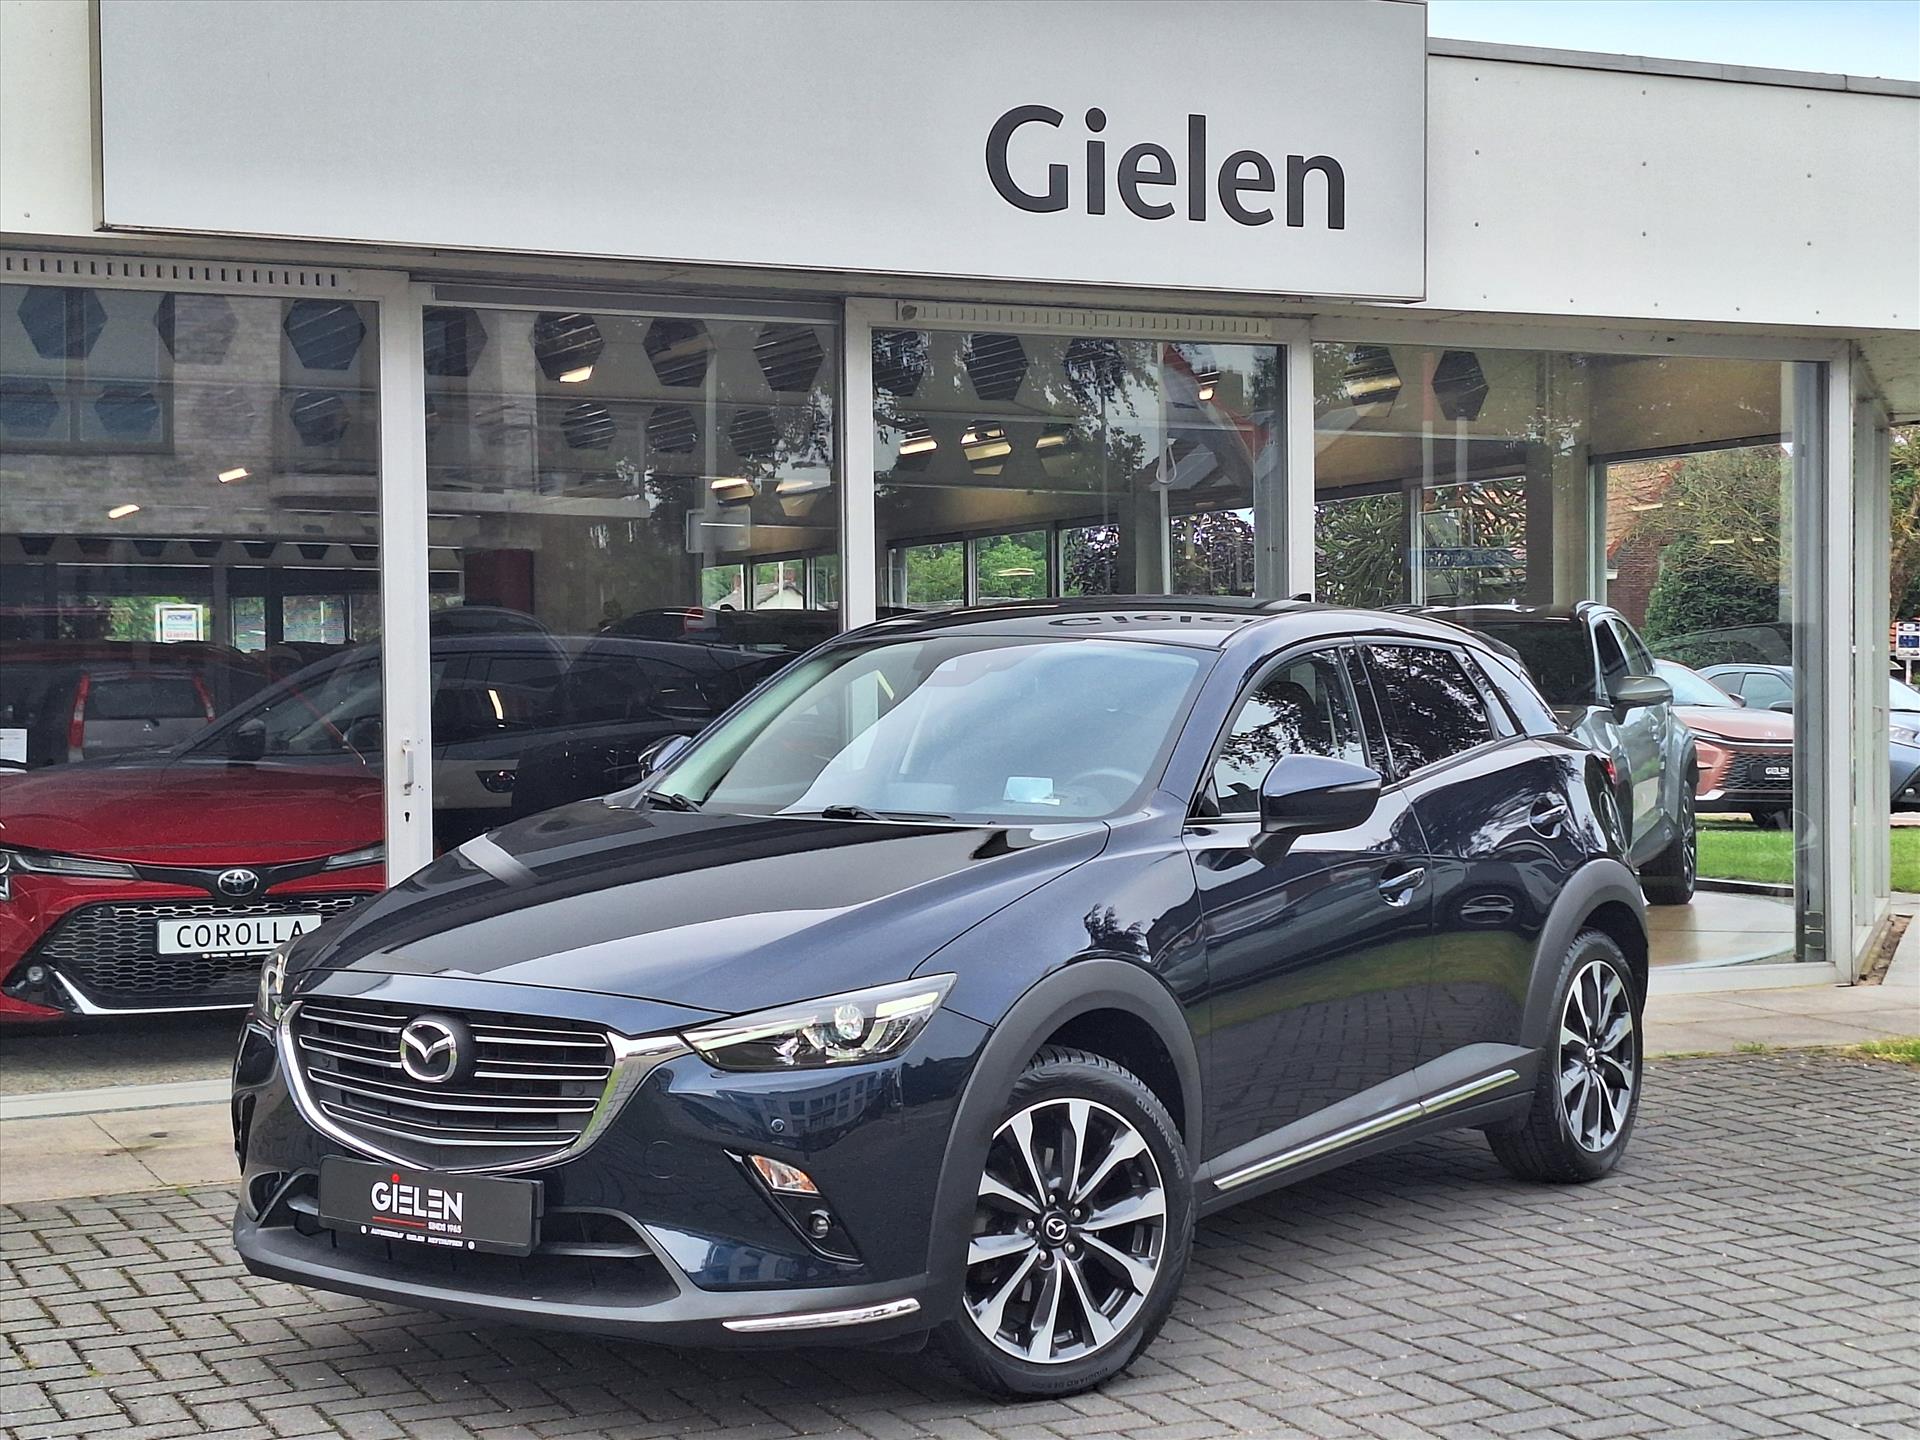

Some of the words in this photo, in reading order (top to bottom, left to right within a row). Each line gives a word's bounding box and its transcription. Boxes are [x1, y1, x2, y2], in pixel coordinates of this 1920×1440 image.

[986, 104, 1346, 231] Gielen
[177, 921, 304, 949] COROLLA
[371, 1173, 463, 1222] GIELEN
